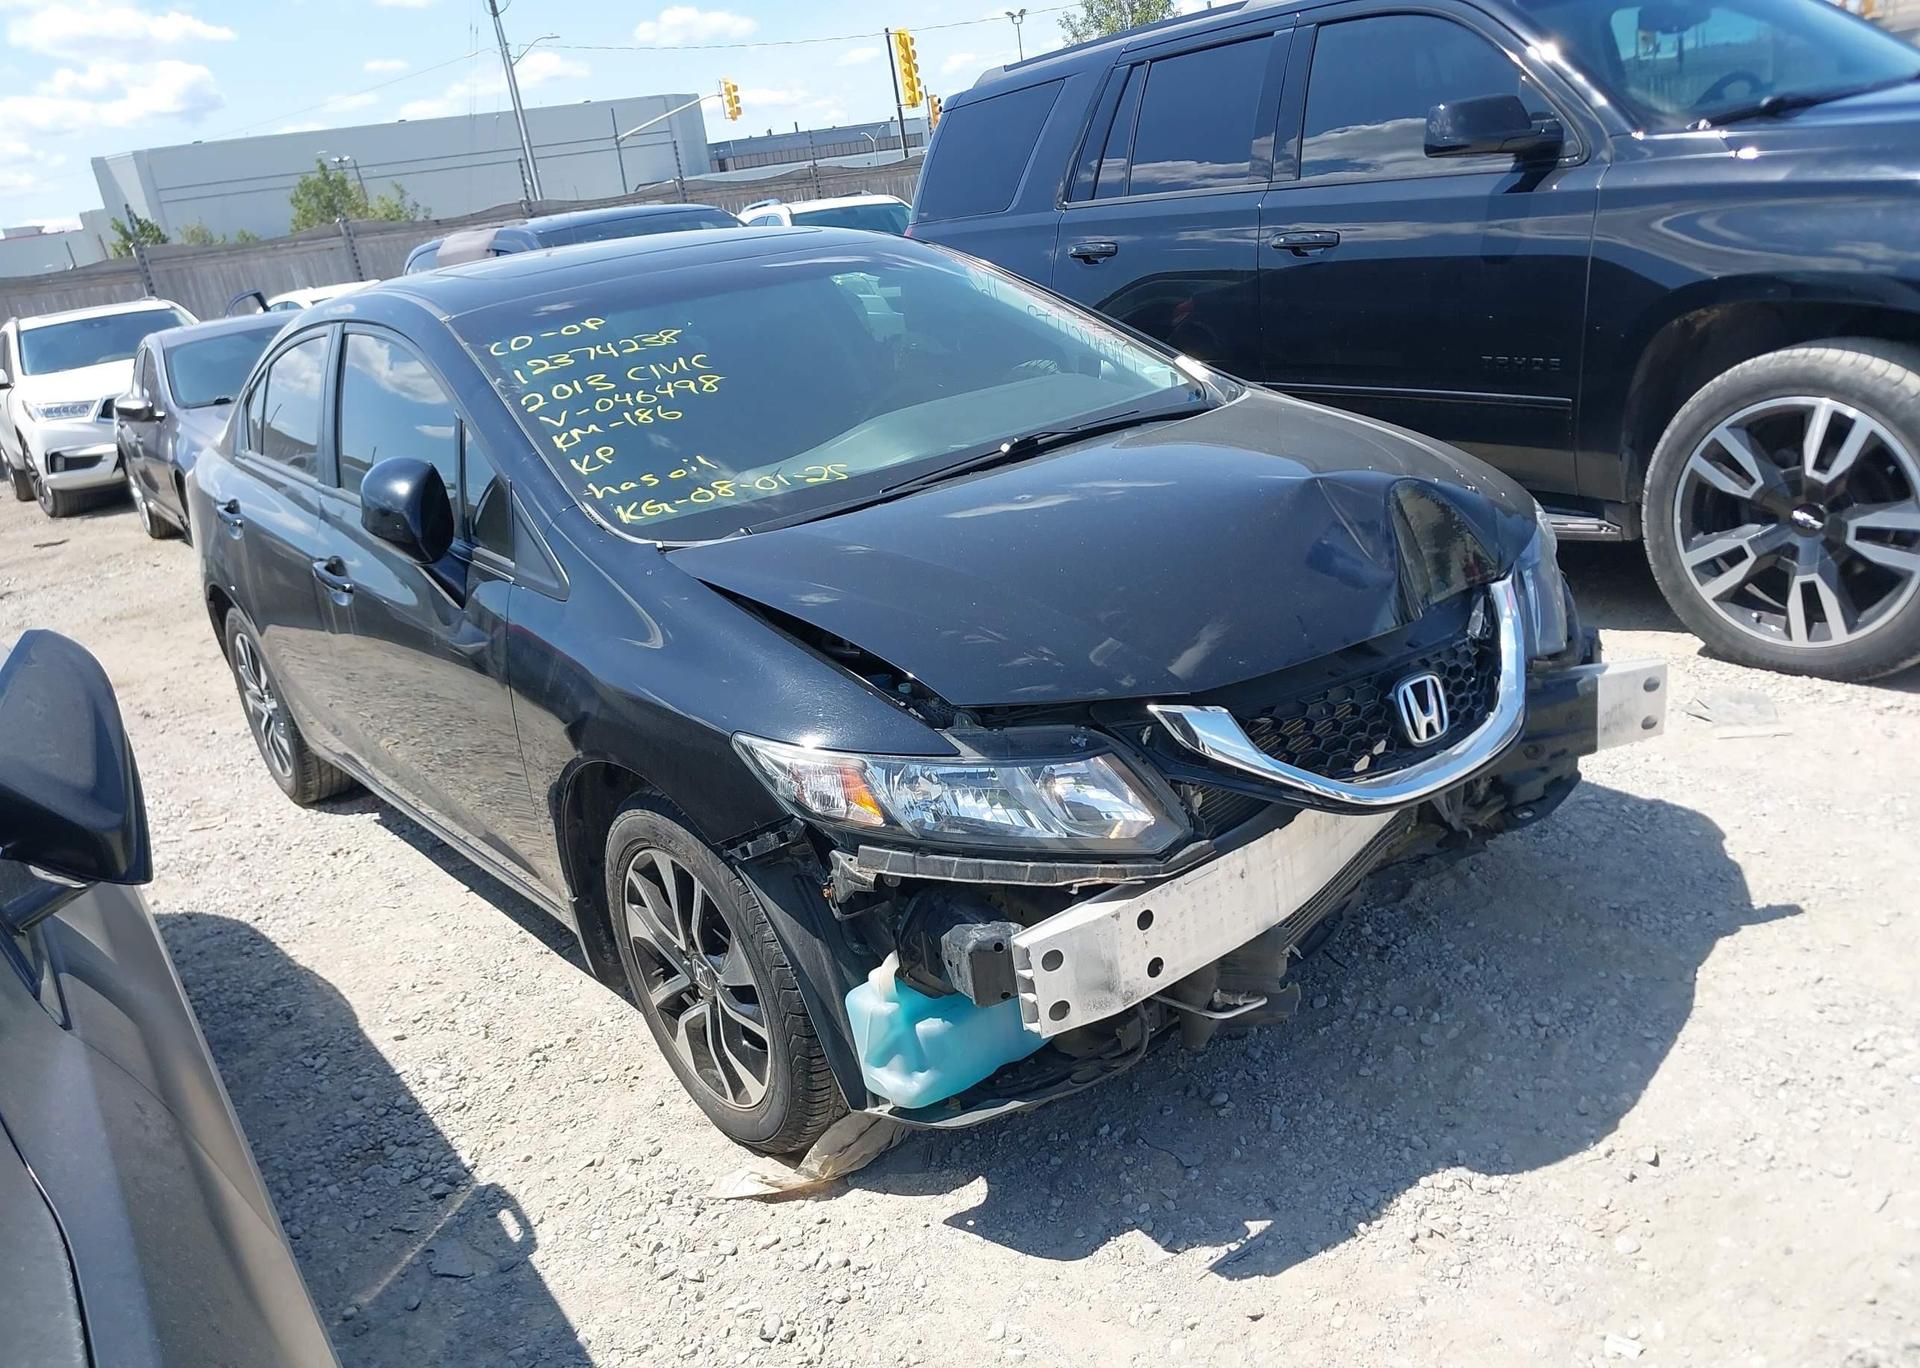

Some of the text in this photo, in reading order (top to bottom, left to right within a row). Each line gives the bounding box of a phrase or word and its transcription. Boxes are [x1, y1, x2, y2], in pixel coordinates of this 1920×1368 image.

[513, 329, 682, 384] 12374238
[520, 354, 713, 412] 2013 CIVIC
[538, 374, 727, 427] V-046498
[552, 405, 683, 452] KM-186
[587, 473, 660, 499] has
